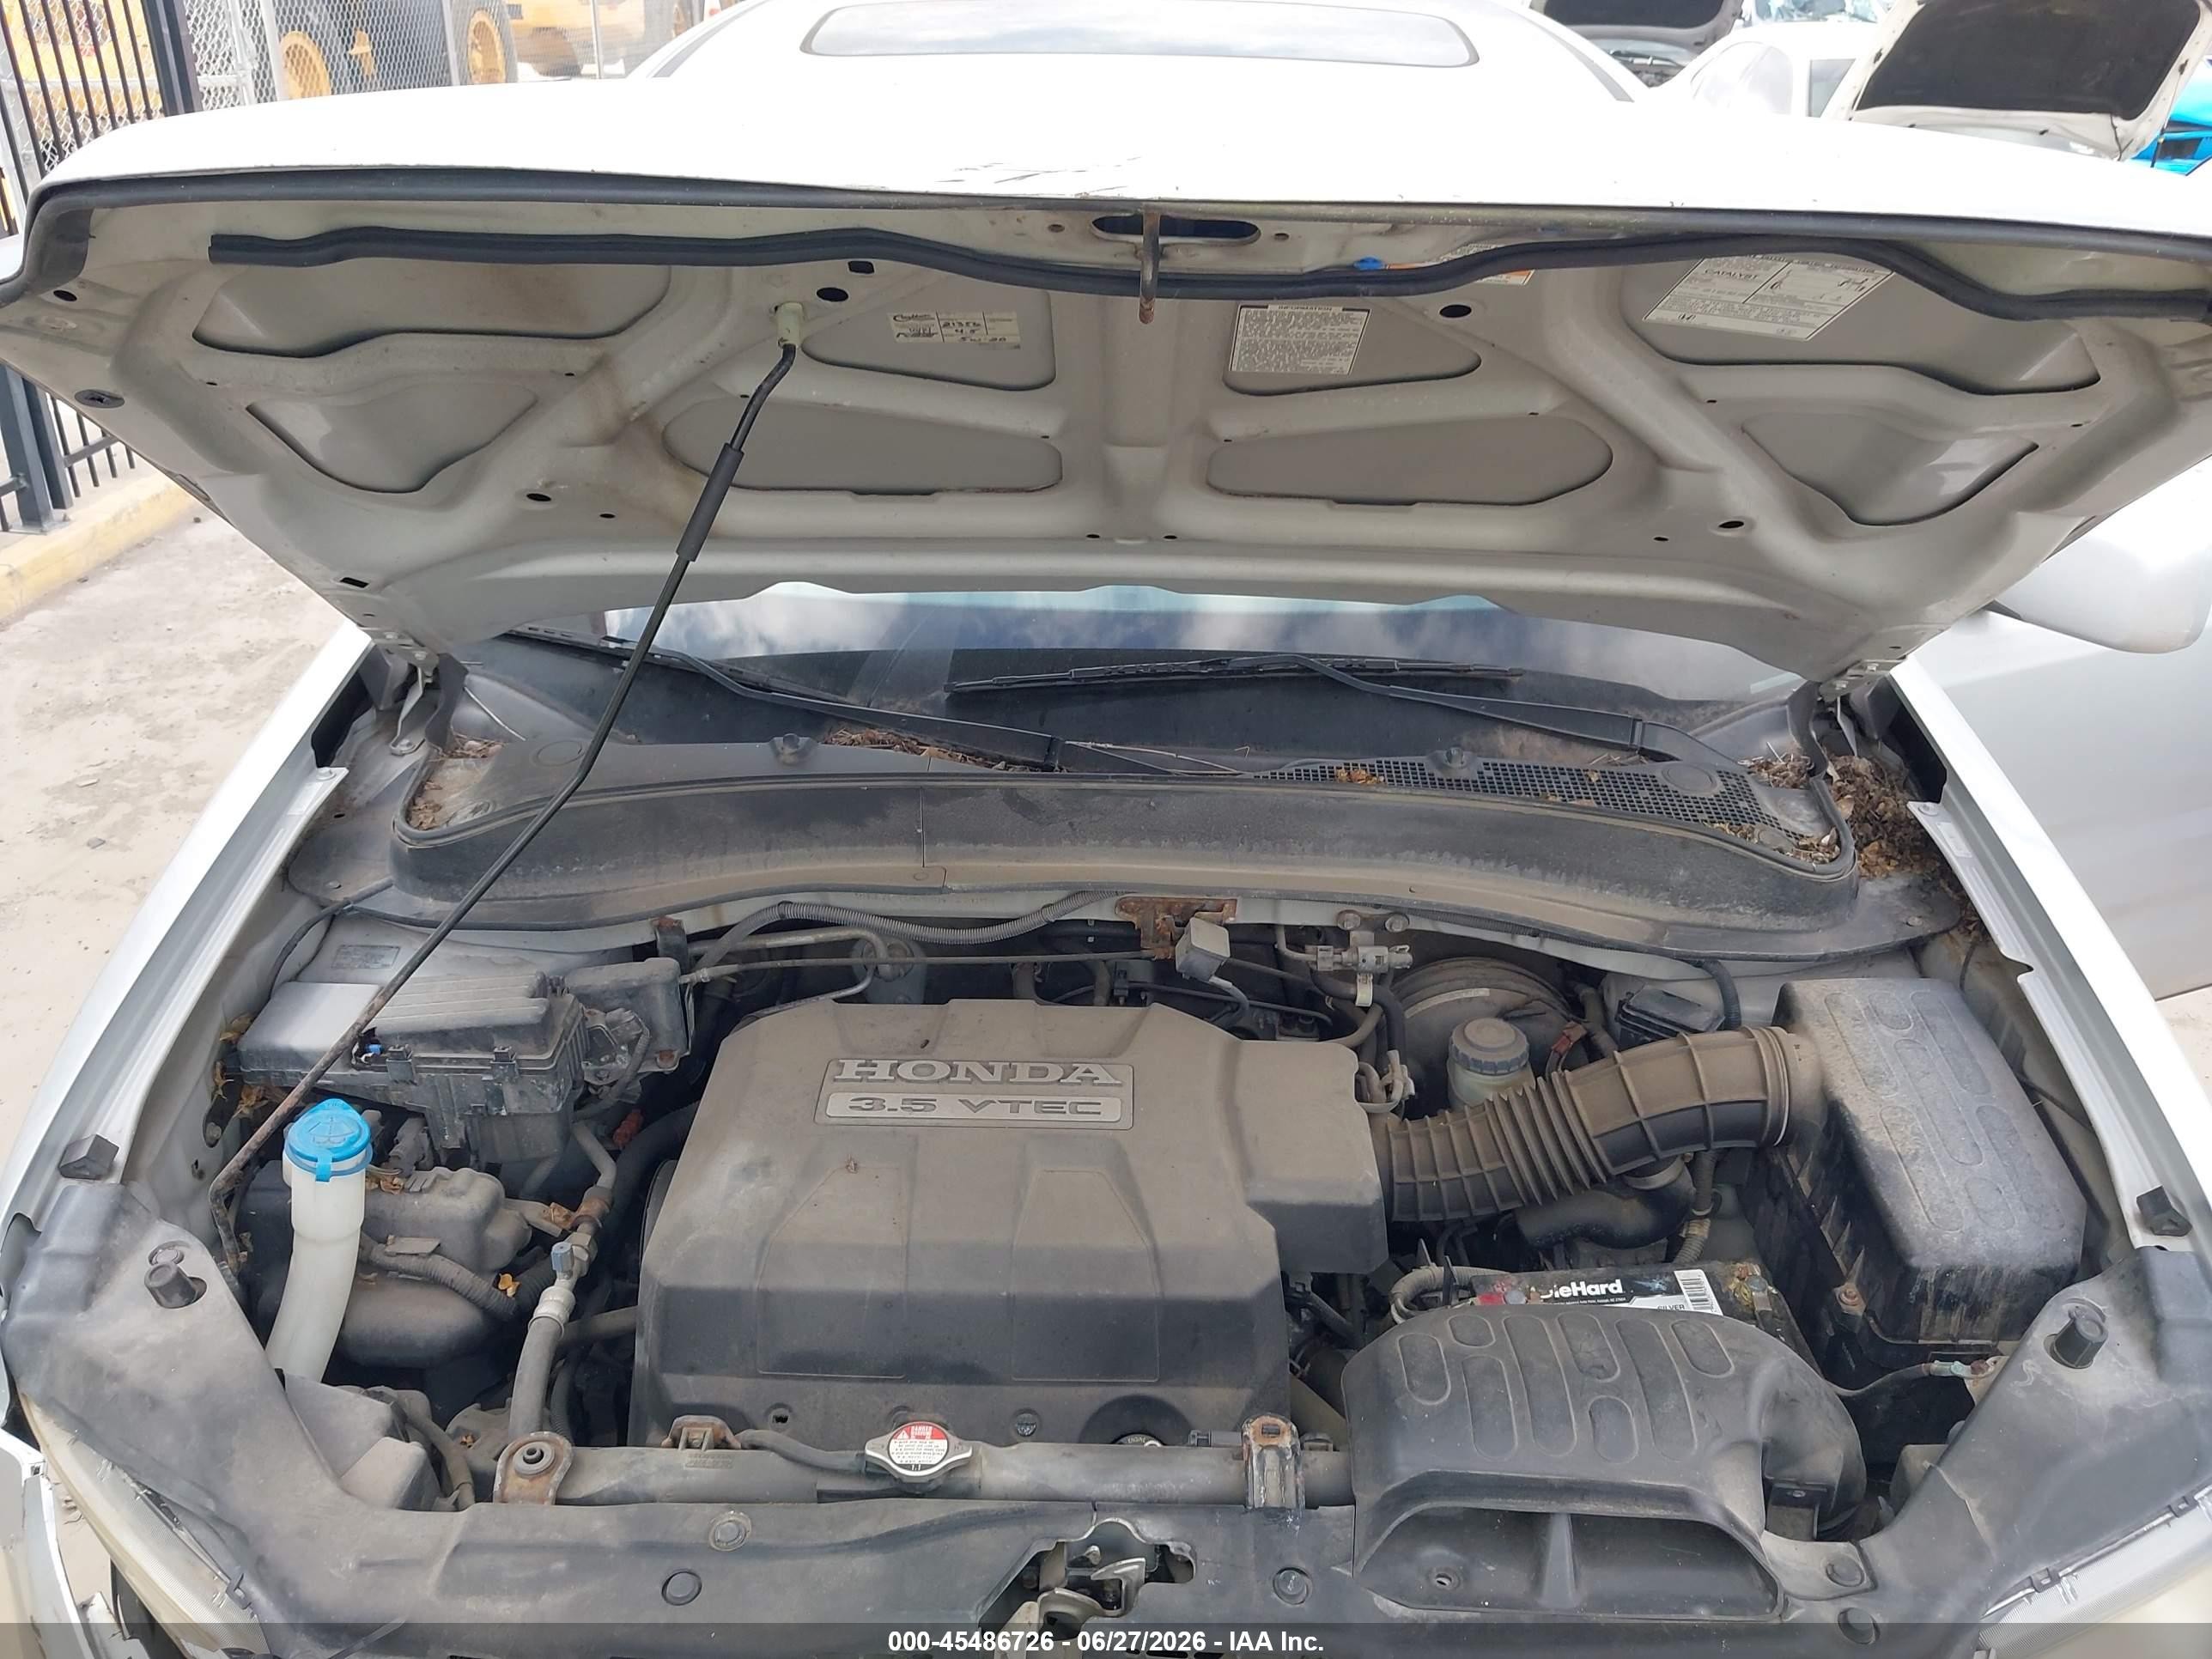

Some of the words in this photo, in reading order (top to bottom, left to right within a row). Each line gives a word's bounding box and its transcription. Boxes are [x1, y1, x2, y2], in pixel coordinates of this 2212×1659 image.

[833, 1059, 1121, 1085] HONDA
[848, 1097, 938, 1113] 3.5
[957, 1098, 1103, 1115] VTEC
